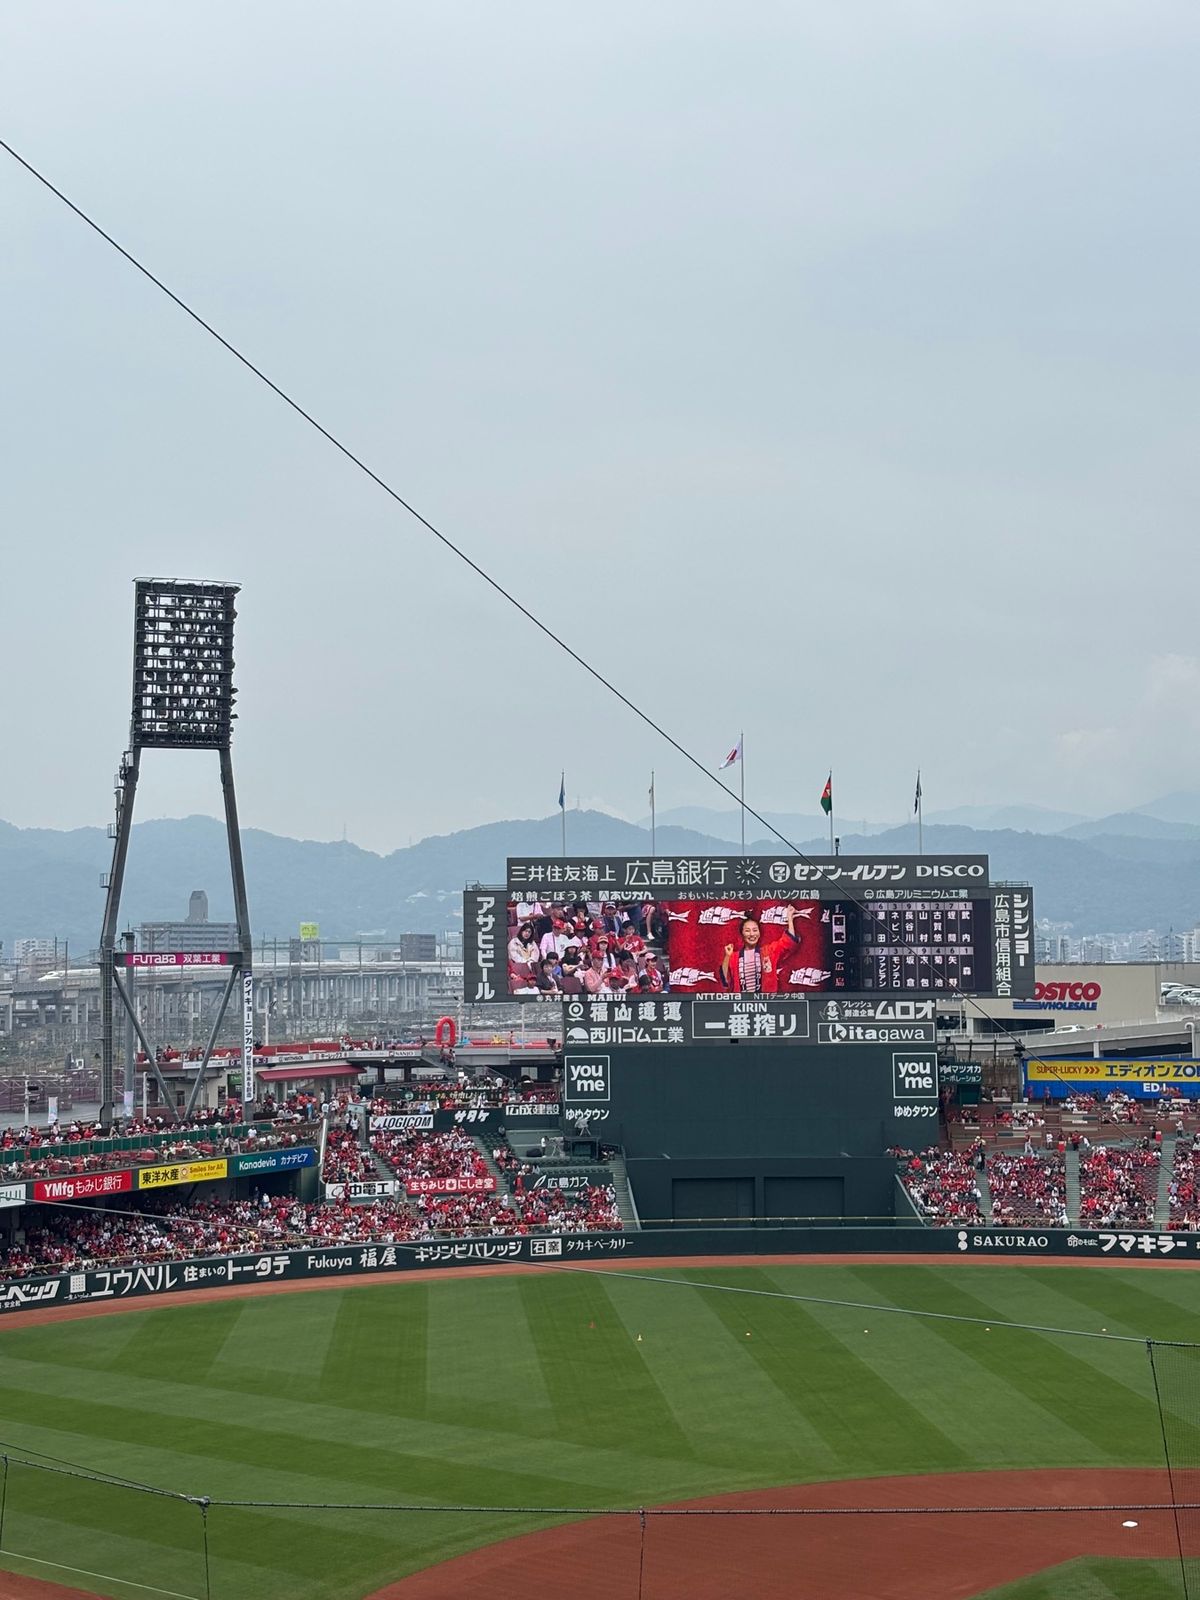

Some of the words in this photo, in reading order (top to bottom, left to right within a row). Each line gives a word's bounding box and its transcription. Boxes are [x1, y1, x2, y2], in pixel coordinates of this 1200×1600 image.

[510, 865, 617, 882] 三井住友海上
[624, 860, 729, 885] 広島銀行
[916, 865, 984, 877] DISCO
[511, 891, 593, 901] 焙煎ごぼう茶
[610, 890, 654, 900] あじかん
[677, 891, 753, 900] おもいに、よりそう
[756, 890, 820, 900] JAバンク広島
[876, 889, 968, 899] 広島アルミニウム工業
[905, 911, 914, 942] 長谷川
[919, 911, 928, 942] 山村
[475, 896, 495, 1000] アサヒビール
[994, 894, 1012, 996] 広島市信用組合
[892, 956, 900, 987] モンテロ
[1034, 982, 1101, 1000] OSTCO
[587, 994, 626, 1002] MARUI
[590, 1002, 682, 1022] 福山通運
[733, 1003, 767, 1012] KIRIN
[875, 1000, 935, 1020] ムロオ
[1039, 1002, 1097, 1011] WHOLESALE
[705, 1014, 797, 1037] 一番搾り
[590, 1027, 684, 1044] 西川ゴム工業
[570, 1065, 602, 1080] you
[898, 1062, 930, 1078] you
[951, 1065, 982, 1073] マツオカ
[1036, 1065, 1083, 1075] SUPER-LUCKY
[1105, 1064, 1170, 1077] エディオン
[576, 1080, 605, 1091] me
[904, 1076, 932, 1088] me
[506, 1104, 560, 1115] 広成建設
[565, 1108, 609, 1120] ゆめタウン
[894, 1106, 938, 1118] ゆめタウン
[383, 1117, 431, 1128] LOGICOM
[454, 1110, 490, 1123] サタケ
[239, 1157, 276, 1171] Kanadevia
[142, 1168, 179, 1185] 東洋水産
[547, 1176, 589, 1189] 広島ガス
[44, 1181, 74, 1198] YMfg
[76, 1176, 122, 1193] もみじ銀行
[350, 1182, 389, 1195] 中電工
[411, 1180, 445, 1191] 生もみじ
[458, 1178, 495, 1190] にしき堂
[566, 1239, 634, 1251] タカキベーカリー
[973, 1236, 1048, 1247] SAKURAO
[1067, 1235, 1098, 1247] 命のそばに
[1099, 1234, 1187, 1254] フマキラー
[415, 1241, 522, 1262] キリンビバレッジ
[308, 1255, 352, 1269] Fukuya
[359, 1248, 398, 1267] 福屋
[184, 1265, 226, 1282] 住まいの
[227, 1256, 290, 1281] トータテ
[95, 1265, 178, 1297] ユウベル
